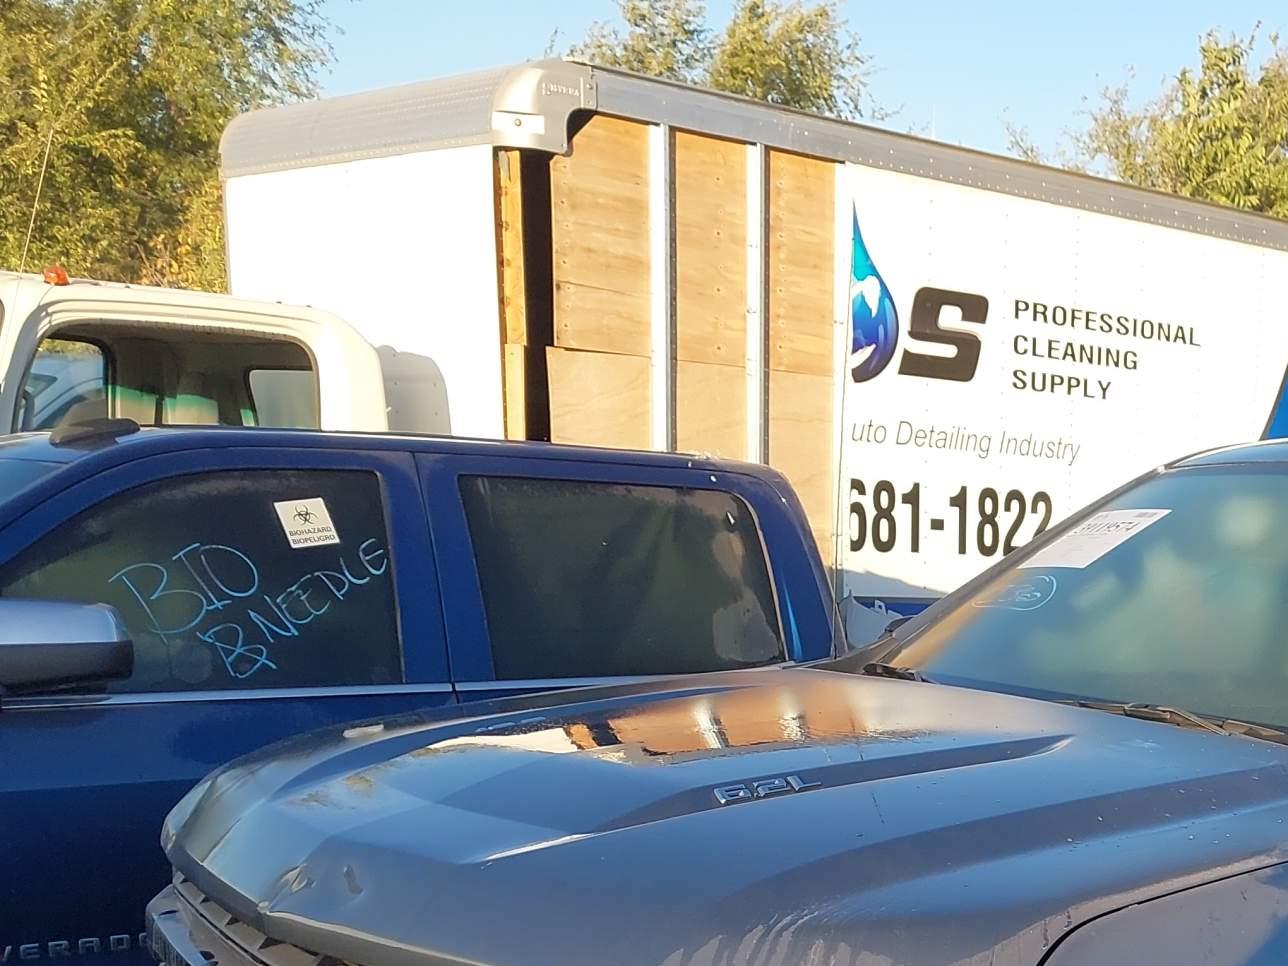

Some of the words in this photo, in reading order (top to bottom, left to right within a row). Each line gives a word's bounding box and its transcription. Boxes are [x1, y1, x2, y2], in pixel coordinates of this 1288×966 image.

[1013, 299, 1201, 347] PROFESSIONAL
[1012, 334, 1138, 370] CLEANING
[1011, 369, 1112, 400] SUPPLY
[895, 420, 992, 459] Detailing
[999, 430, 1081, 466] Industry
[288, 526, 333, 537] BIOHAZARD
[290, 534, 336, 545] BIOPELIGRO
[849, 477, 1053, 557] 681-1822
[108, 542, 259, 646] BIO
[247, 537, 388, 643] NEEDLE
